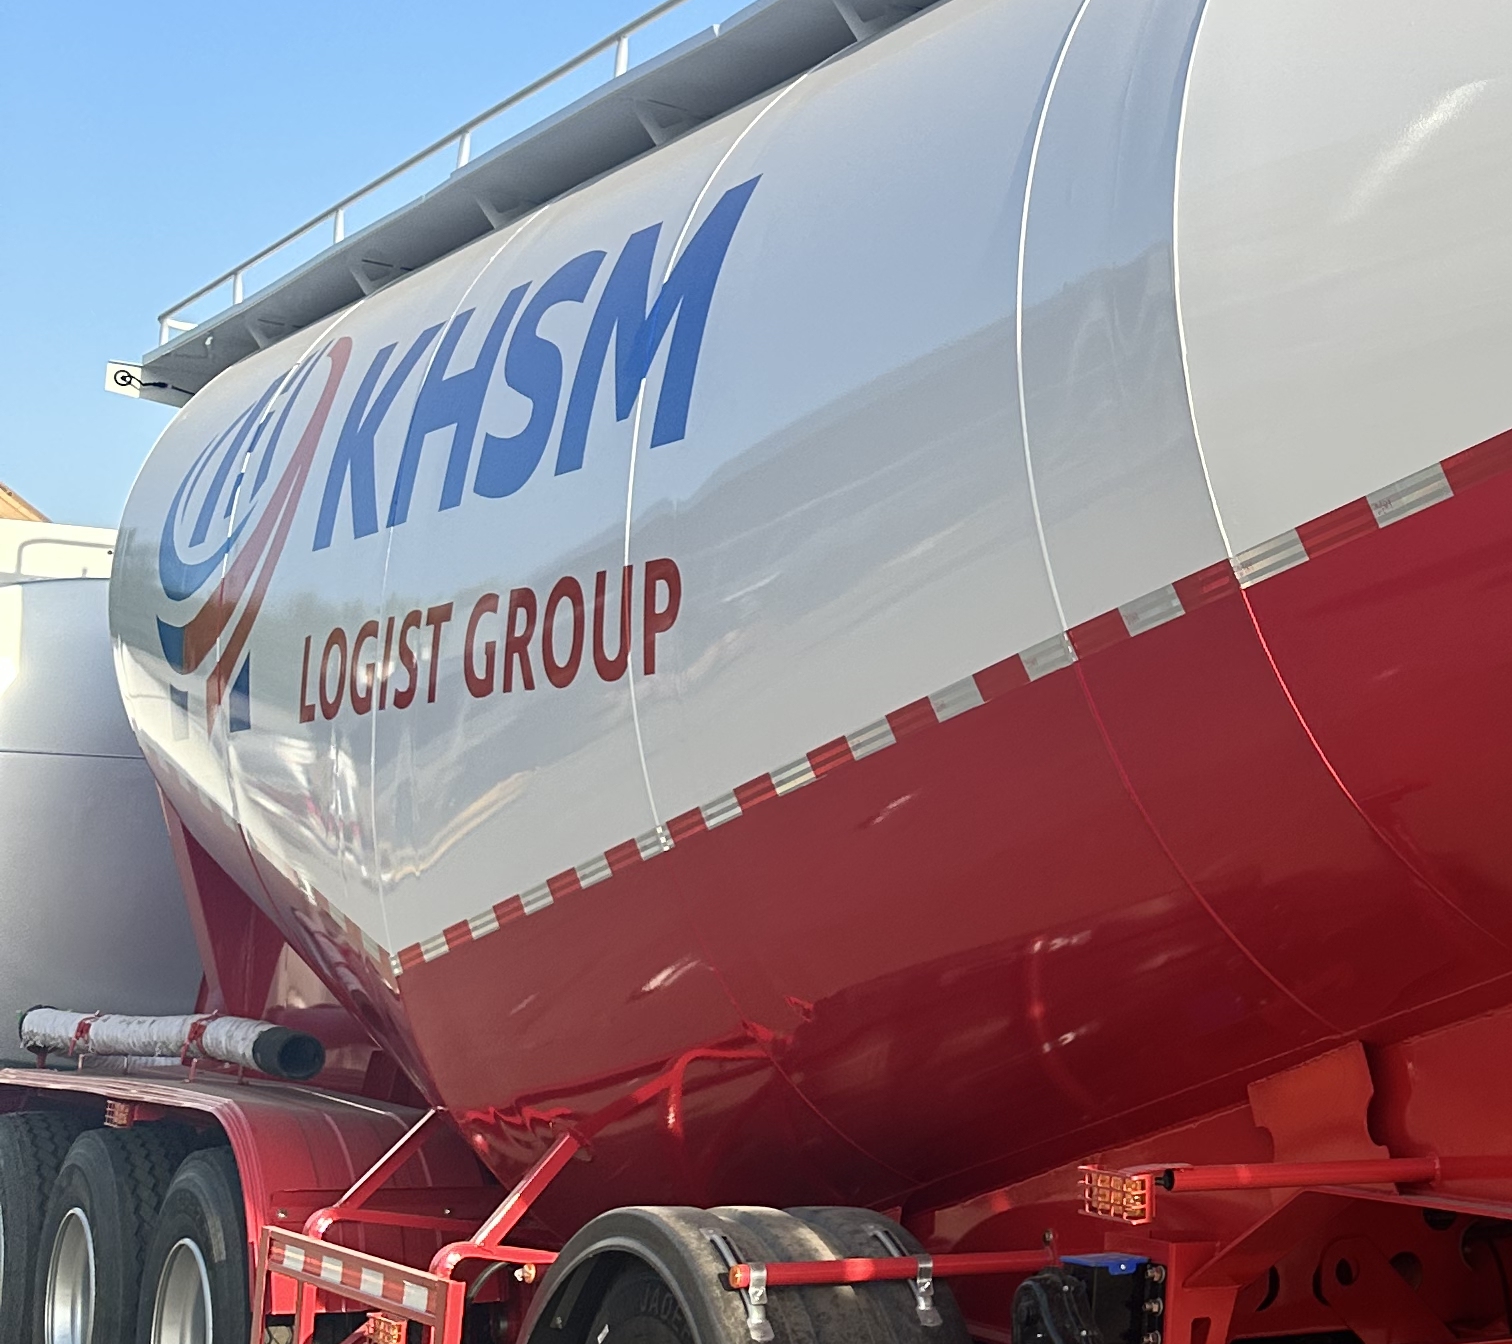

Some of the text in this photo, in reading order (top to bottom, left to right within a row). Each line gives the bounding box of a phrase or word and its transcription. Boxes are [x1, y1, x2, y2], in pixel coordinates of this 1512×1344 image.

[311, 172, 763, 552] KHSM
[299, 556, 682, 724] LOGIST GROUP
